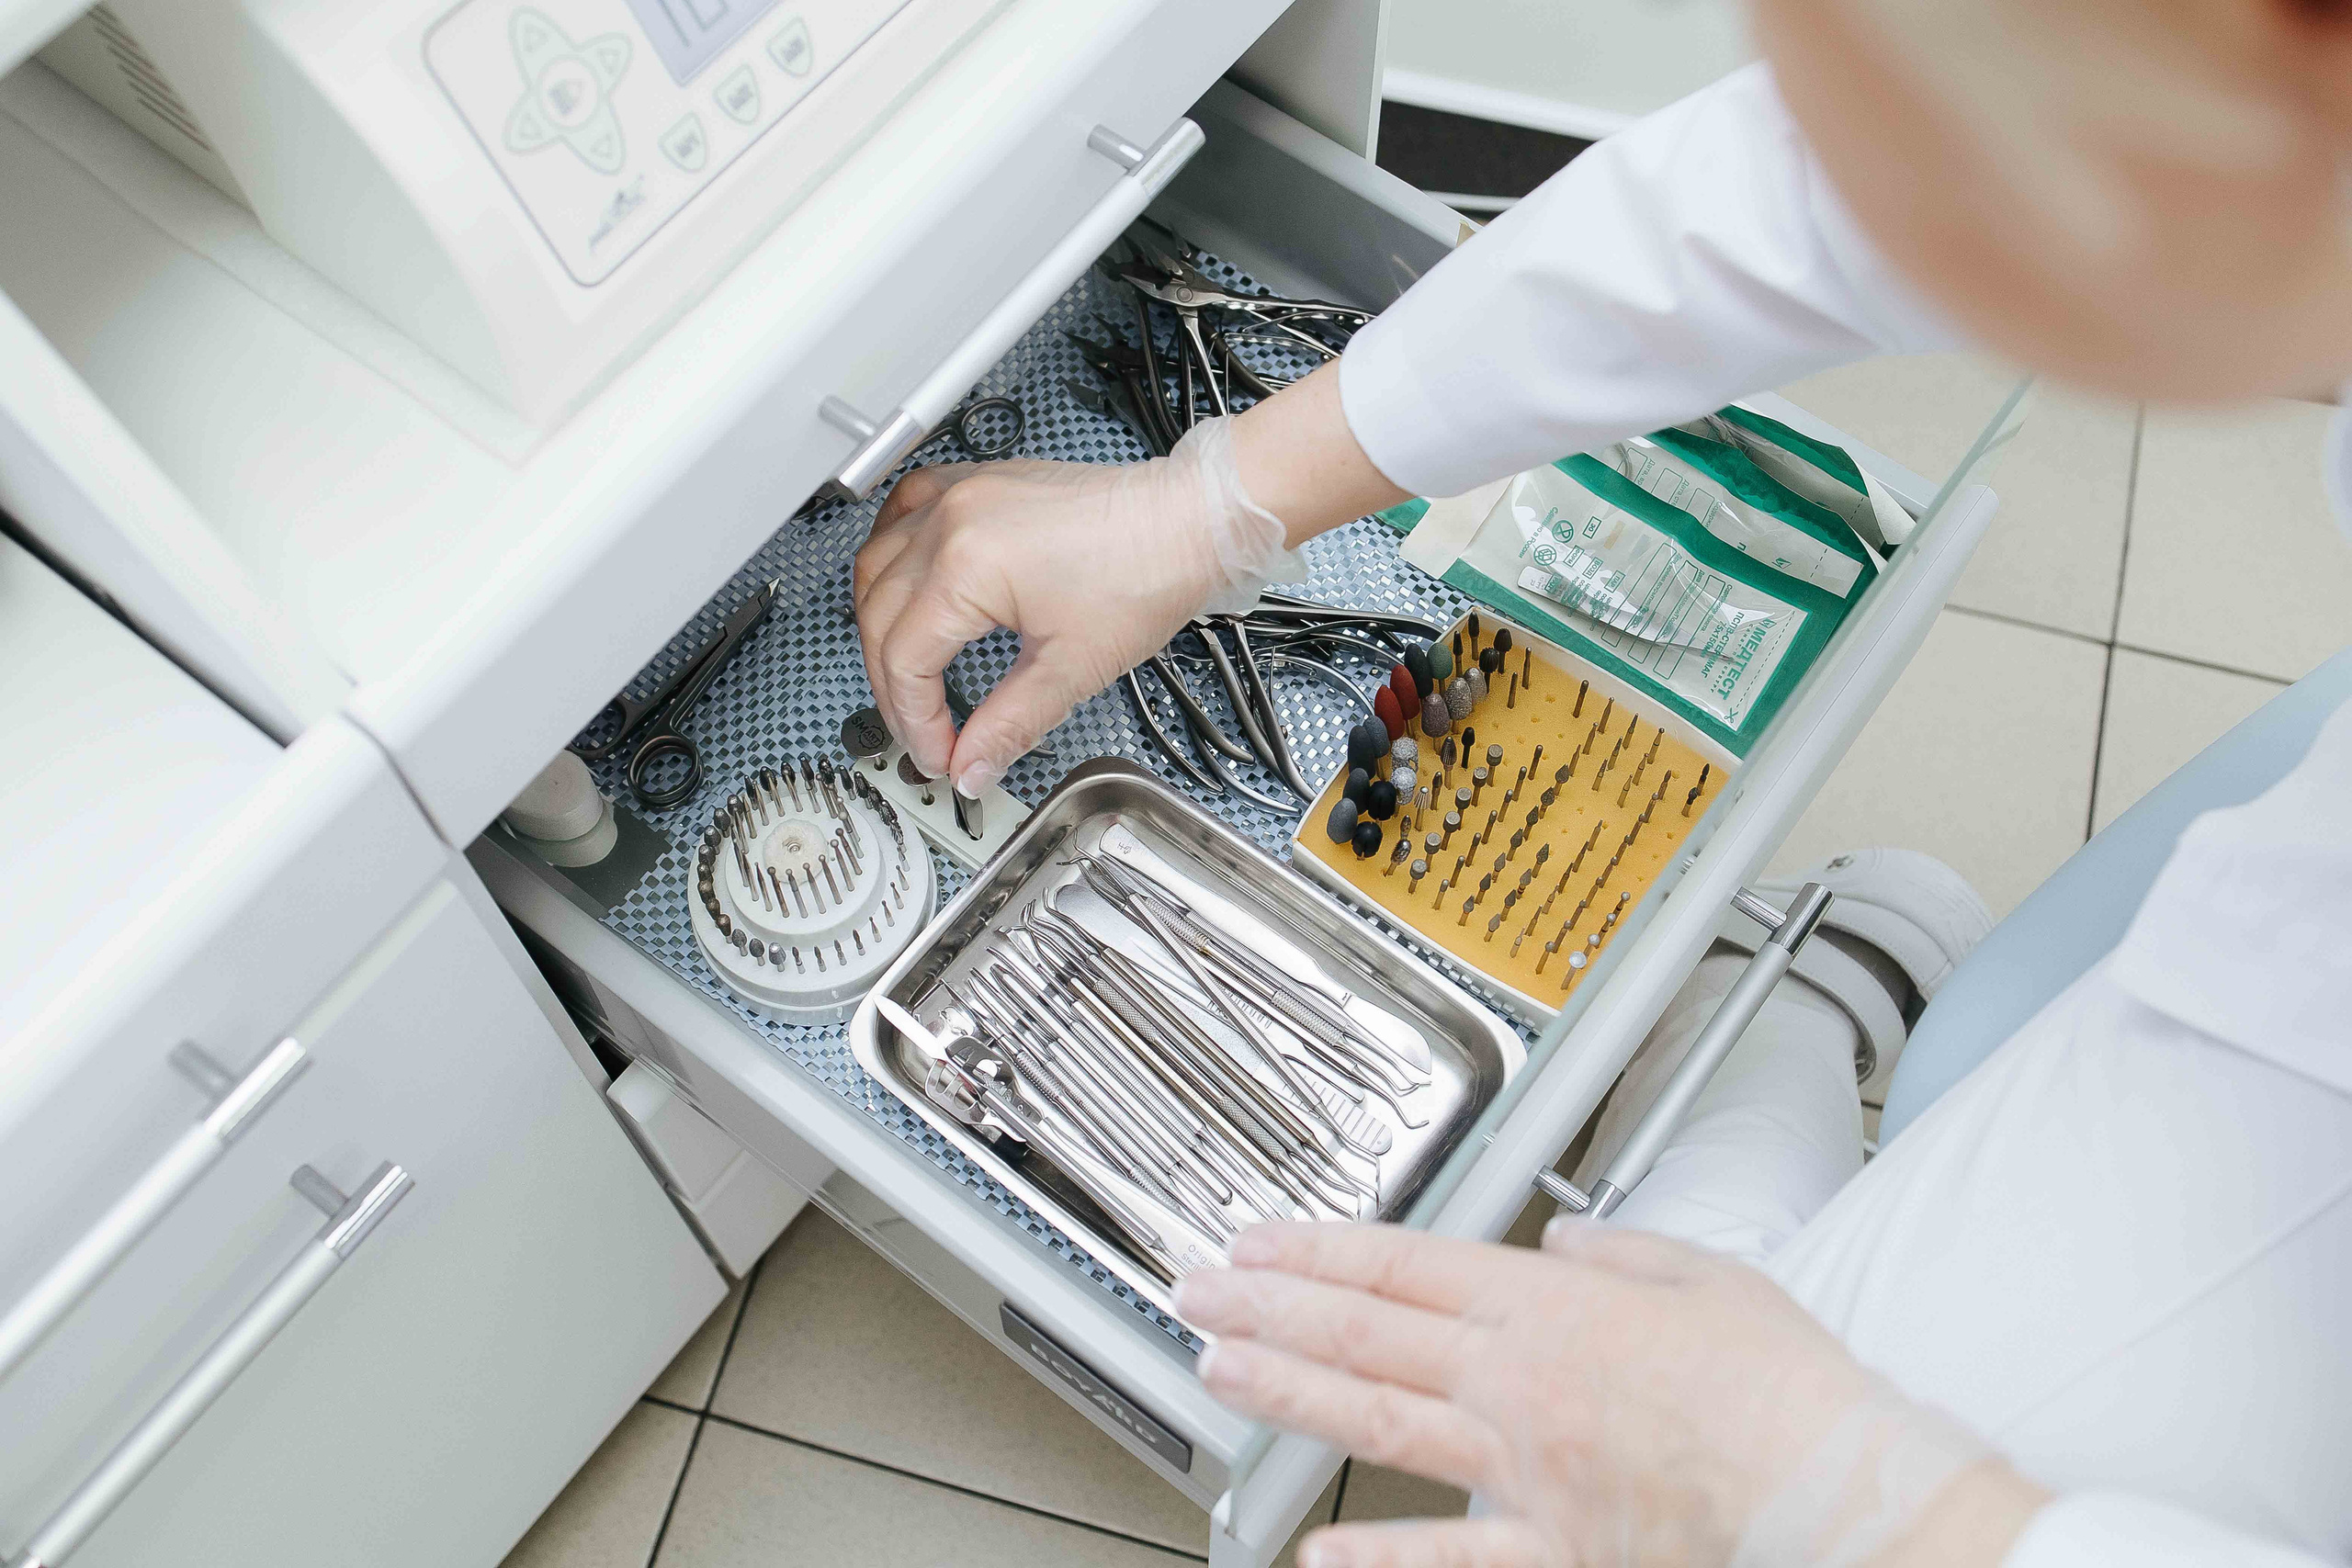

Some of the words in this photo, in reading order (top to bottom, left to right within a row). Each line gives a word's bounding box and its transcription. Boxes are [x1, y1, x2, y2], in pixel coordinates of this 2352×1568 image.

[1643, 458, 1656, 477] Дата,
[1678, 479, 1690, 497] Дата
[1705, 502, 1722, 529] Содержи
[1711, 623, 1754, 693] САНКТ-ПТЕРБУРГ
[1716, 626, 1767, 700] МЕДТЕСТ
[852, 716, 880, 743] SMART
[1188, 1245, 1216, 1269] Origin
